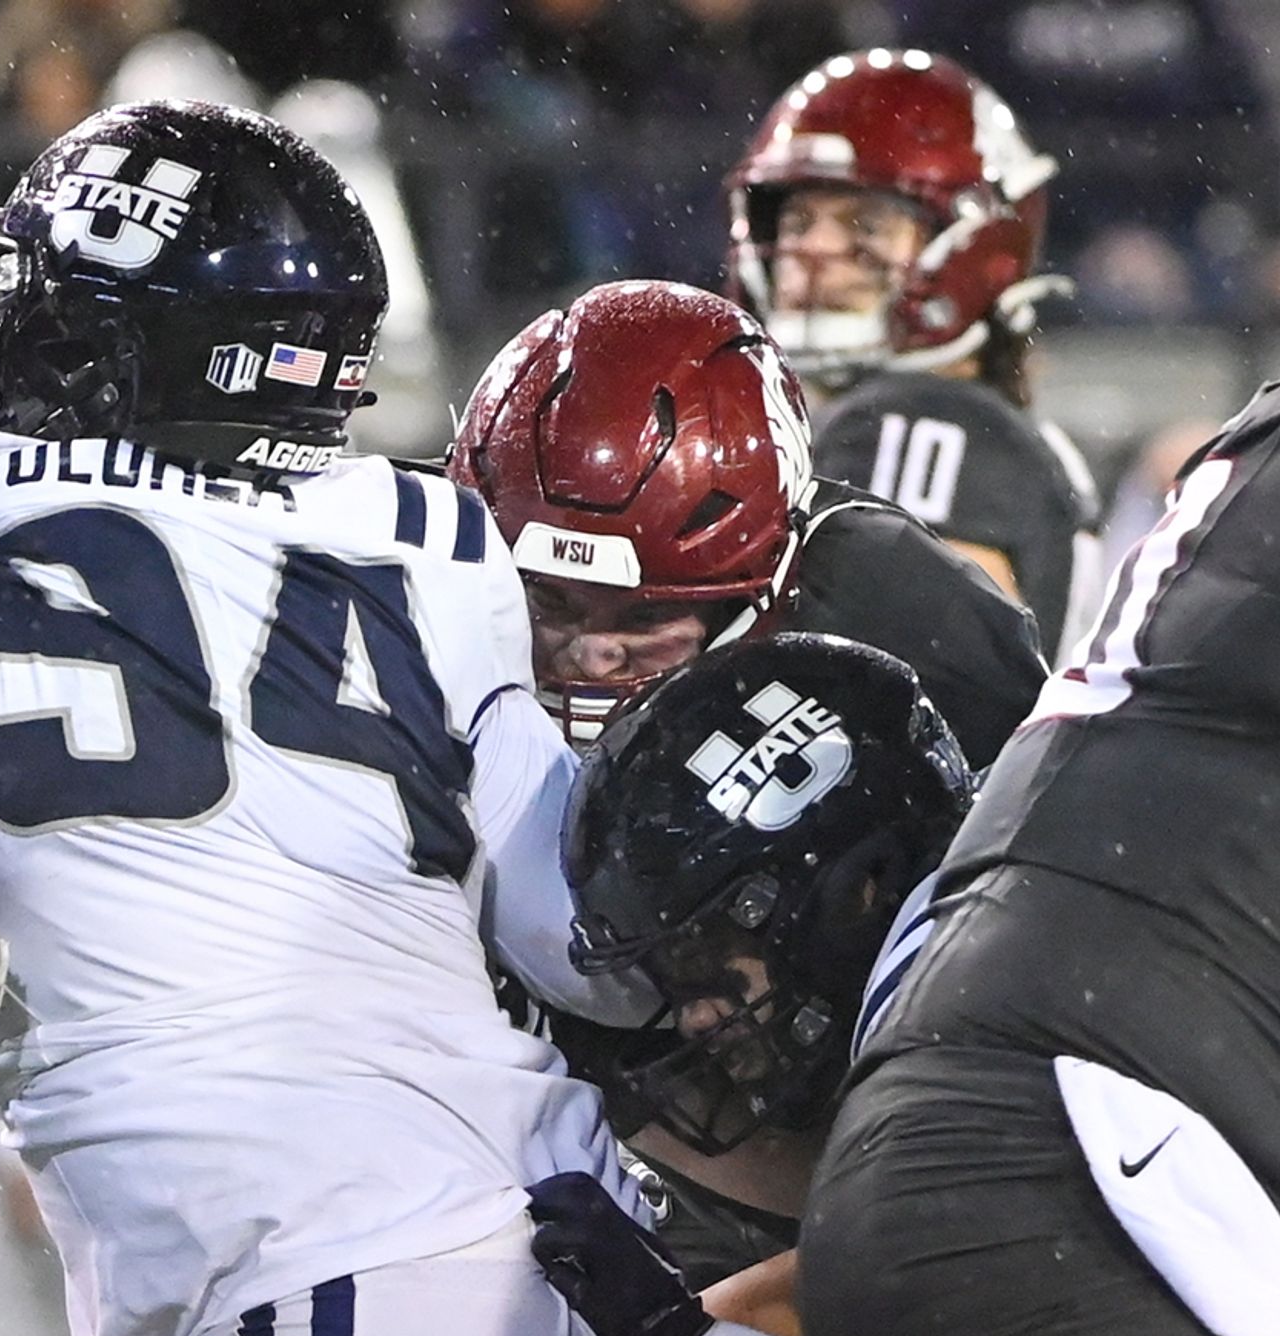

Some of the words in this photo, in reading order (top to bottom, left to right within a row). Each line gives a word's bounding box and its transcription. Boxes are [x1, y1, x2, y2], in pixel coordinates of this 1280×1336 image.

[42, 174, 191, 241] STATE
[868, 412, 968, 525] 10
[552, 535, 596, 566] WSU
[706, 696, 842, 822] STATE
